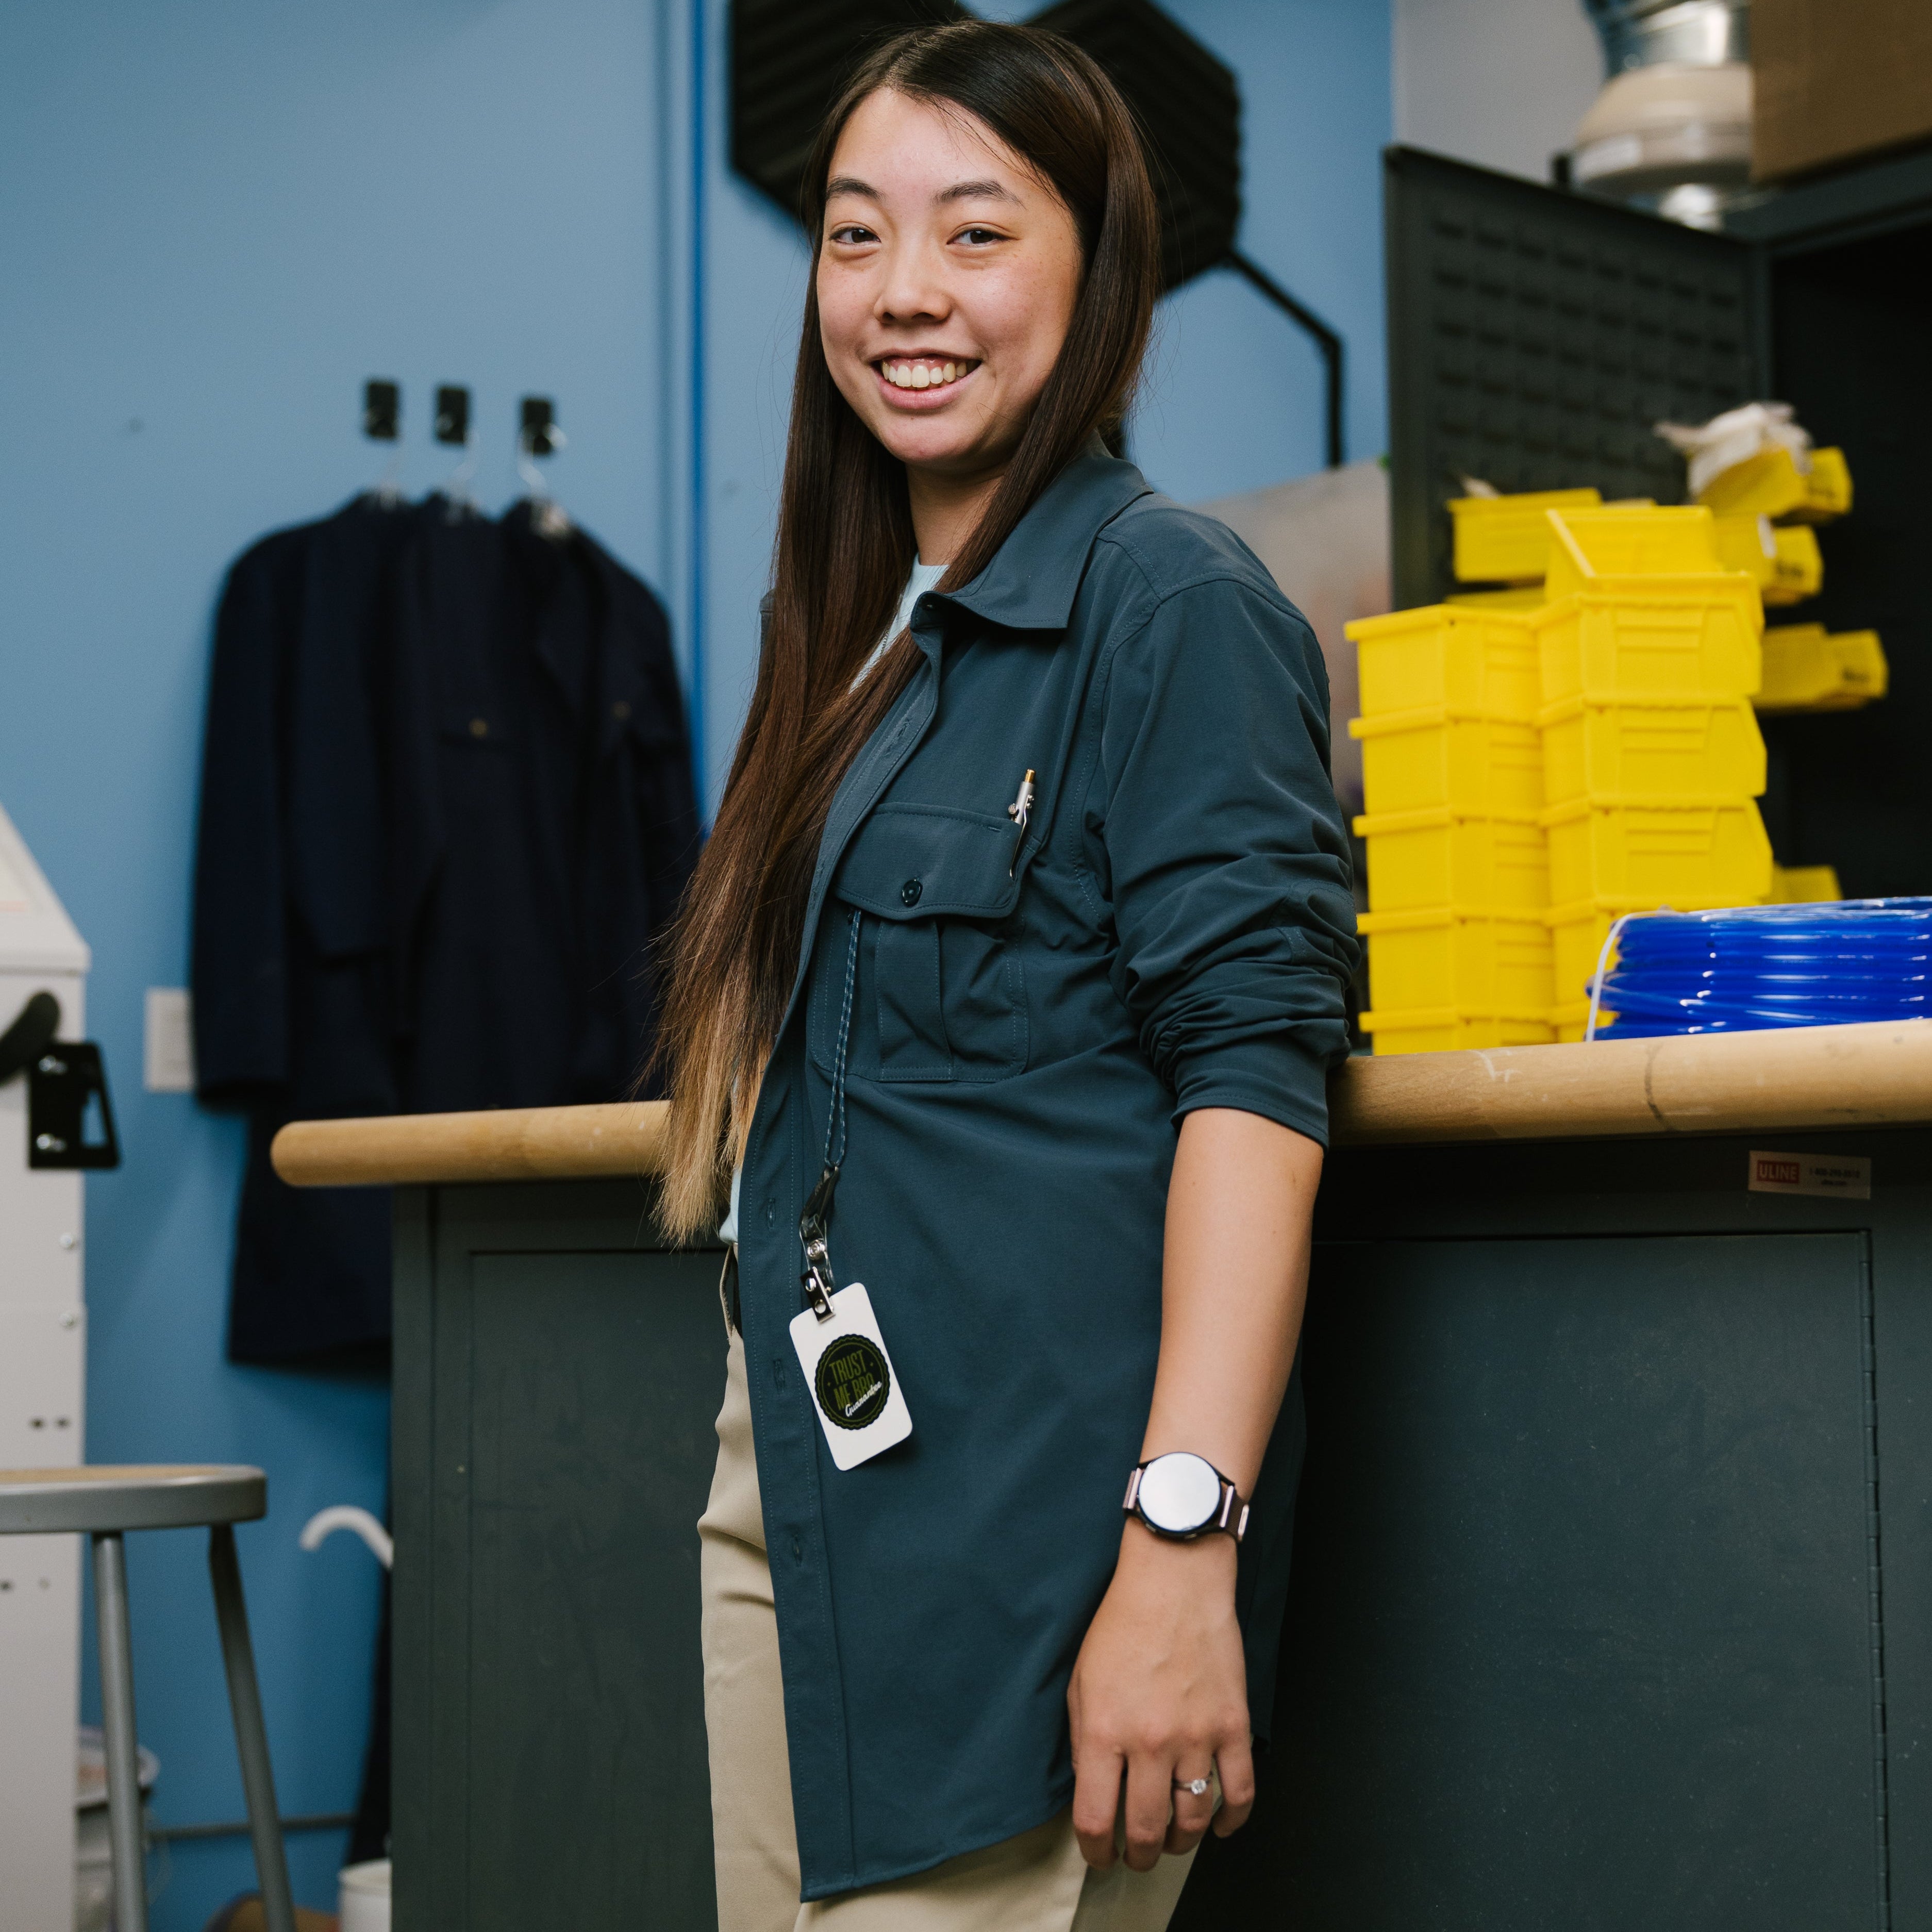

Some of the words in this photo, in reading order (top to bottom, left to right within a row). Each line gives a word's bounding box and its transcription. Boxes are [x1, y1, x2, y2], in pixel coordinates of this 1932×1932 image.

[1759, 1164, 1797, 1180] ULINE
[829, 1350, 867, 1385] TRUST
[833, 1384, 853, 1411] ME
[845, 1380, 882, 1418] Guarantee
